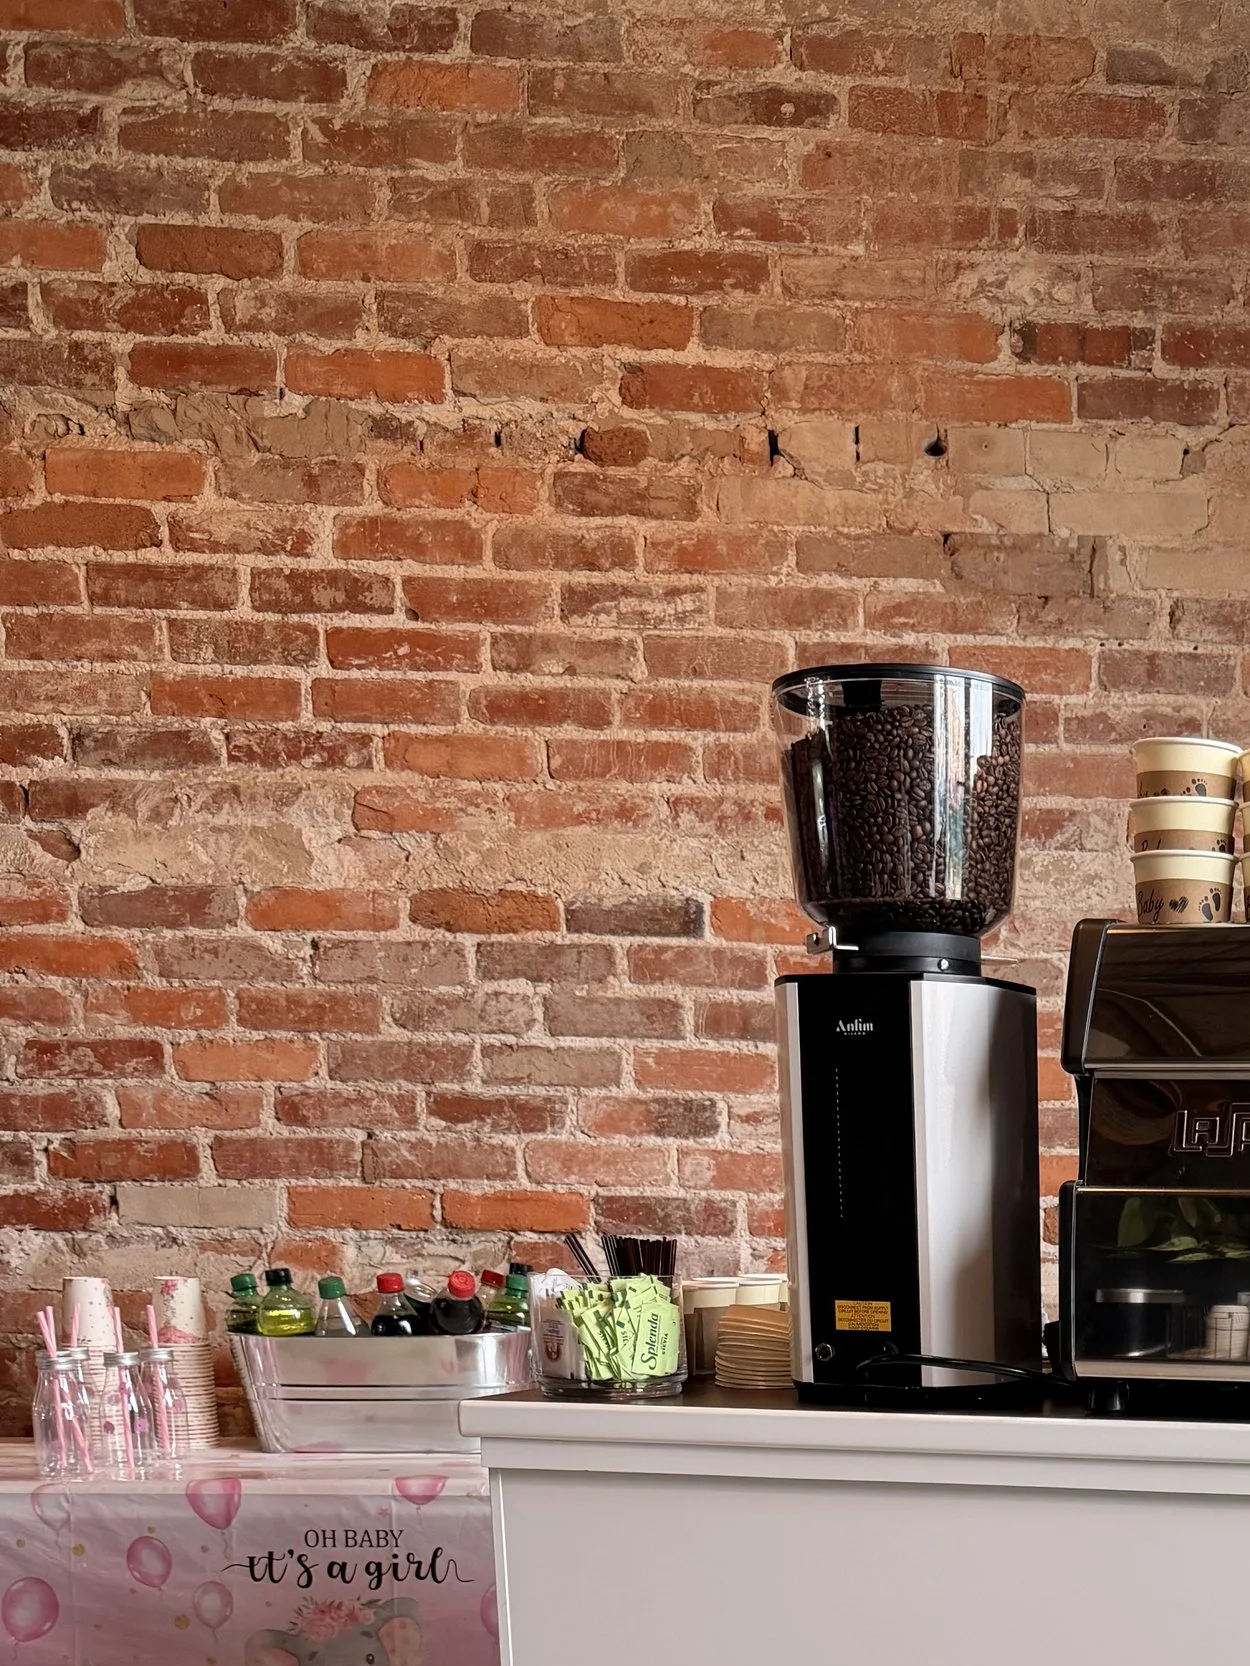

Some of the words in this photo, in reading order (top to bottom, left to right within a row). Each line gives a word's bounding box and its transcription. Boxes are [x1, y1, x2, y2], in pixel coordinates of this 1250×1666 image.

[1137, 888, 1165, 921] Baby
[836, 1018, 874, 1032] Anfim
[641, 1312, 659, 1370] Splenda
[304, 1529, 337, 1548] OH
[344, 1529, 404, 1548] BABY
[220, 1549, 319, 1589] it's
[327, 1560, 357, 1584] a
[364, 1547, 475, 1590] girl
